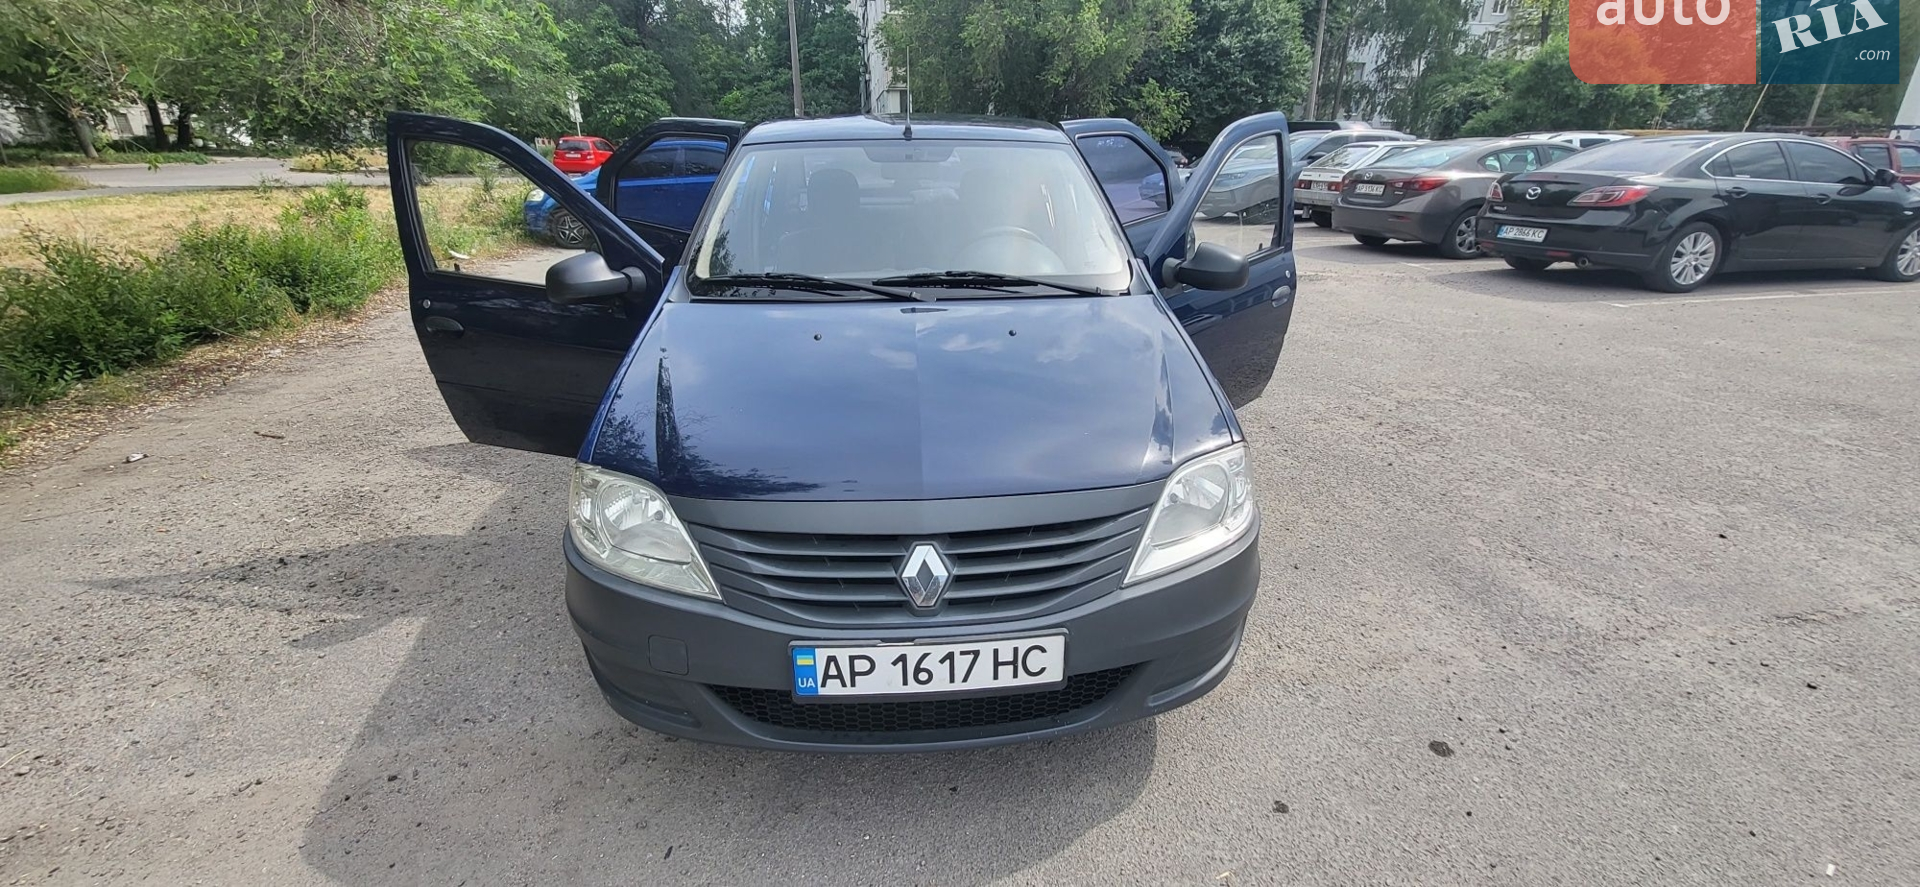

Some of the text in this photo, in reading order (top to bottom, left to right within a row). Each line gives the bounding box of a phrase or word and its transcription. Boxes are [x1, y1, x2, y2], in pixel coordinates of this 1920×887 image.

[1503, 227, 1544, 239] AP 2866 KC
[820, 644, 1048, 688] AP 1617 HC
[798, 677, 816, 688] UA
